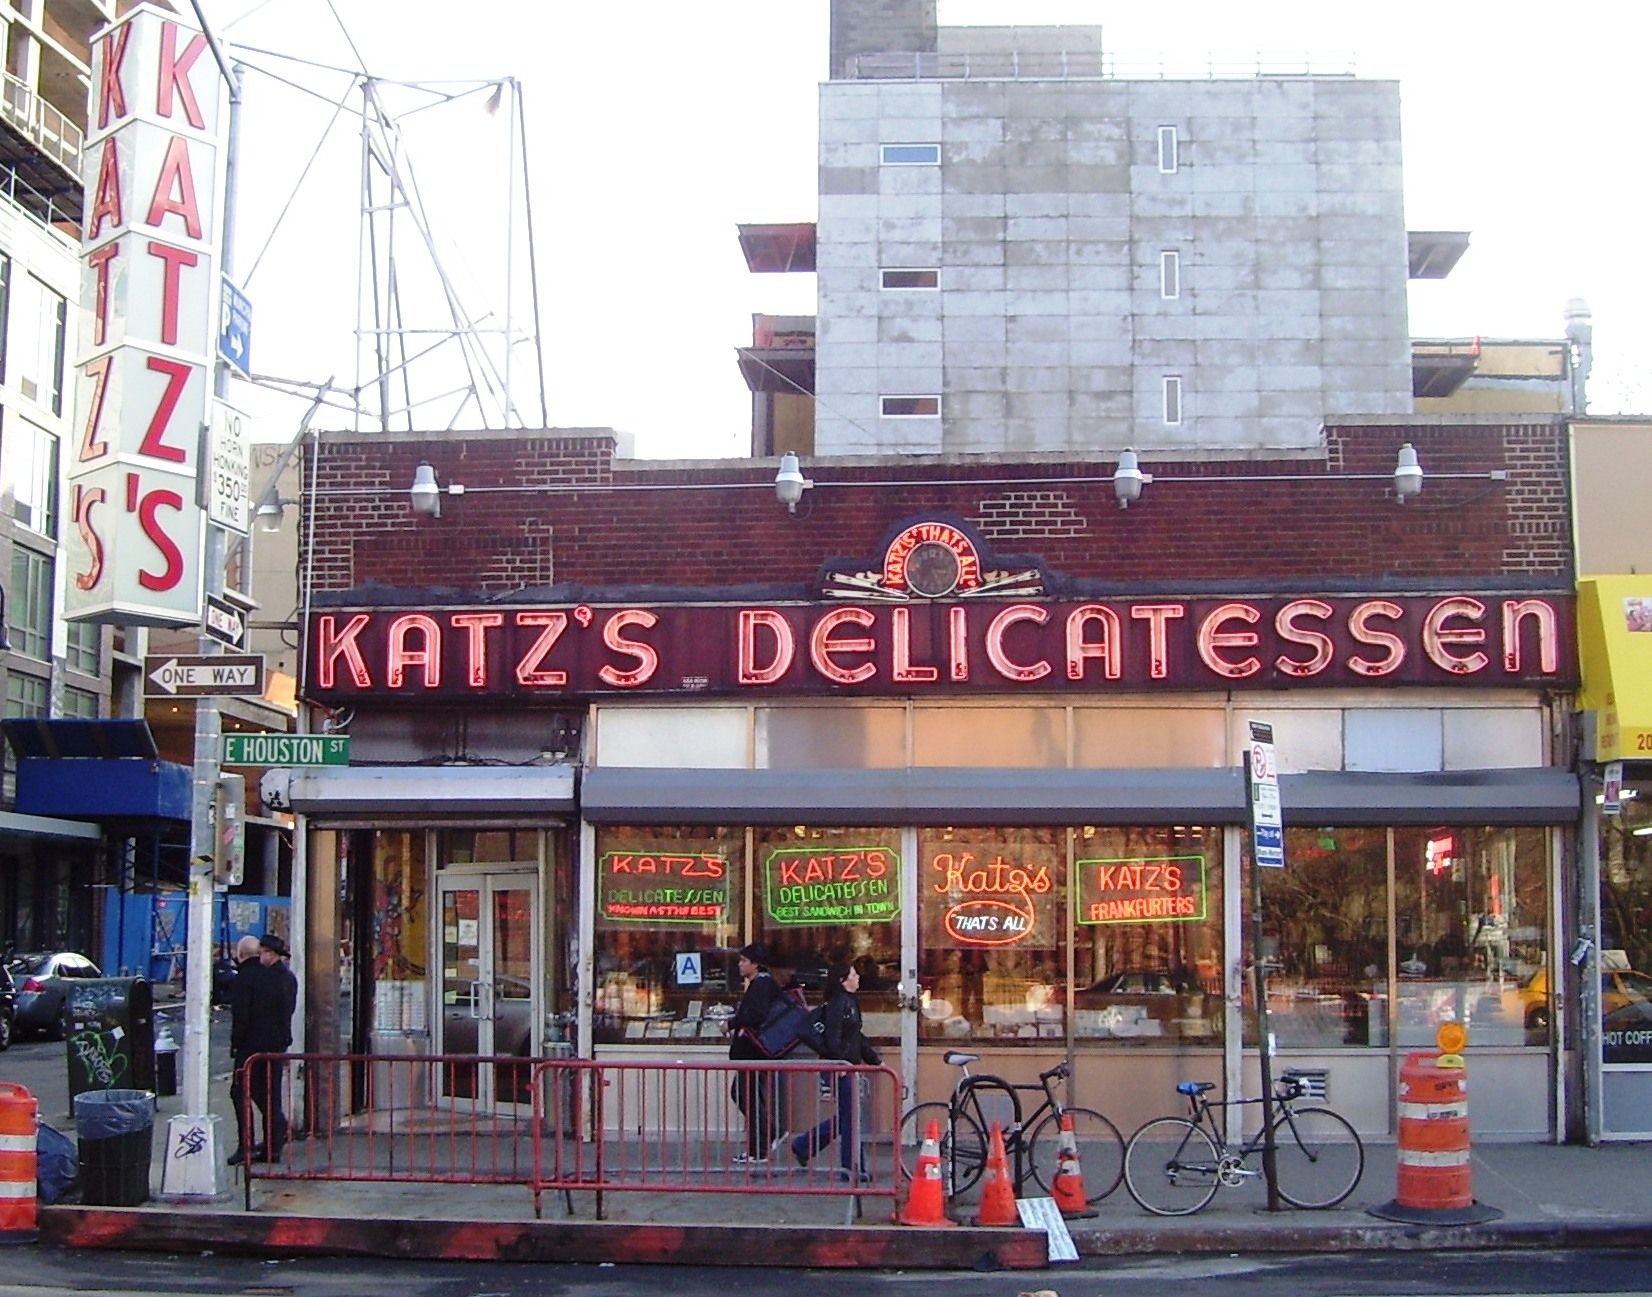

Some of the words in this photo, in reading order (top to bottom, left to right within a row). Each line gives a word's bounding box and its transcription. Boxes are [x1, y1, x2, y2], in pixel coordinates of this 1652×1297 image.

[72, 21, 133, 592] KATZ'S
[126, 21, 210, 593] KATZ'S
[225, 411, 241, 437] NO
[220, 501, 239, 522] FINE
[318, 604, 659, 688] KATZ'S
[162, 668, 196, 684] ONE
[212, 668, 248, 684] WAY
[225, 737, 236, 761] E
[242, 738, 323, 764] HOUSTON
[330, 740, 345, 753] ST
[780, 851, 887, 885] KATZ'S
[933, 852, 1051, 893] Katz's
[1100, 863, 1181, 891] KATZ'S
[608, 889, 724, 904] DELICATESSEN
[780, 879, 888, 904] DELICATESSEN
[776, 906, 801, 918] BEST
[803, 905, 852, 918] SANDWICH
[853, 904, 864, 916] IN
[866, 901, 895, 914] TOWN
[1089, 896, 1195, 920] FRANKFURTERS
[1003, 916, 1026, 931] ALL
[681, 956, 698, 975] A
[1602, 1031, 1623, 1045] HOT
